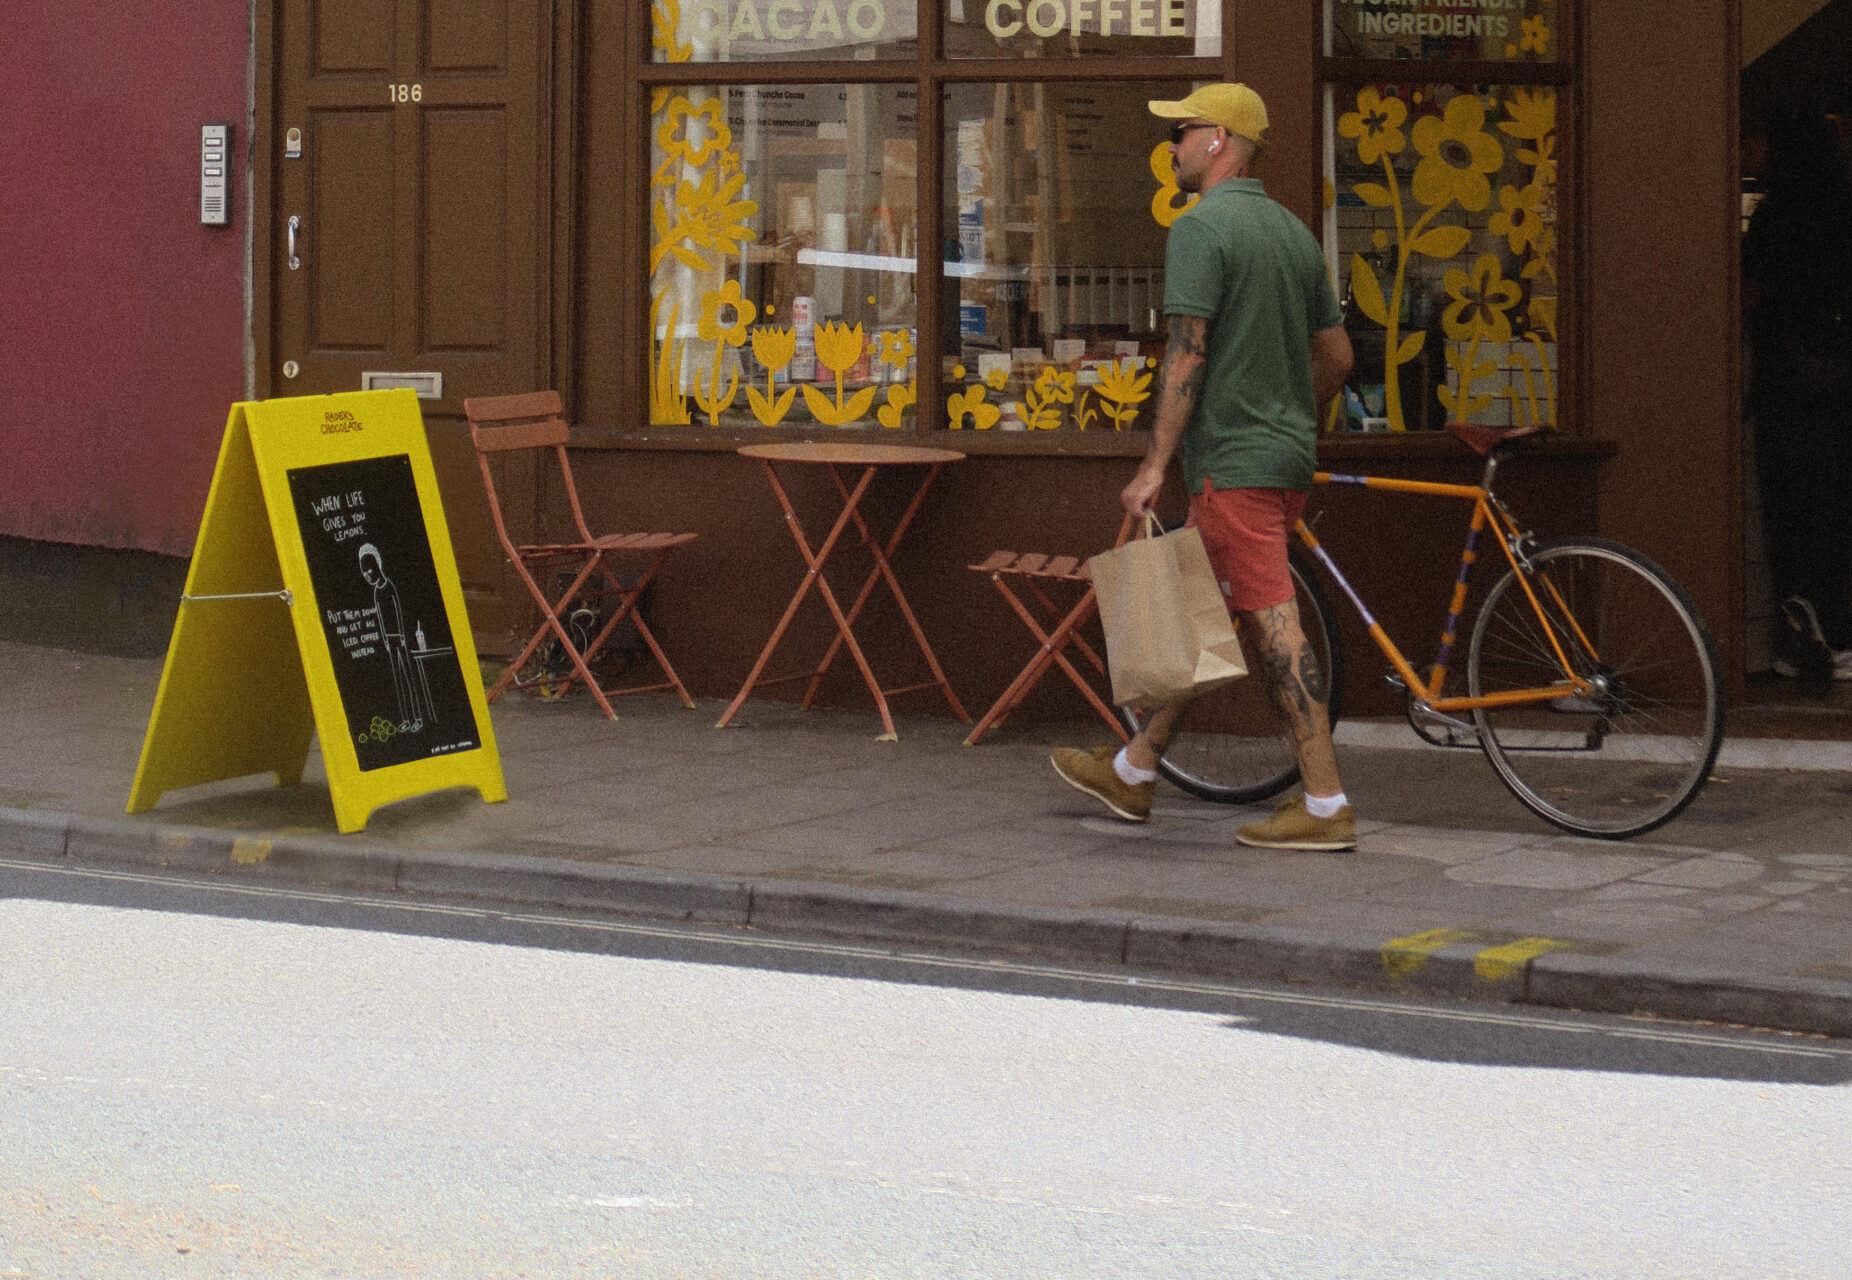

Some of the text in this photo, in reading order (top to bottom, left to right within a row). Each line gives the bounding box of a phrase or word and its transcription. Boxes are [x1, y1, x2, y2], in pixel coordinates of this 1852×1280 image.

[1357, 11, 1509, 38] INGREDIENTS
[388, 84, 422, 102] 186
[320, 421, 364, 435] CHOCOLATE
[310, 490, 365, 516] WHEN LIFE
[322, 512, 366, 532] GIVES YOU
[326, 609, 341, 624] PUT
[343, 609, 361, 621] THEM
[336, 619, 375, 635] AND GET AN
[342, 631, 380, 649] ICED COFFEE
[351, 646, 375, 660] INSTEAD
